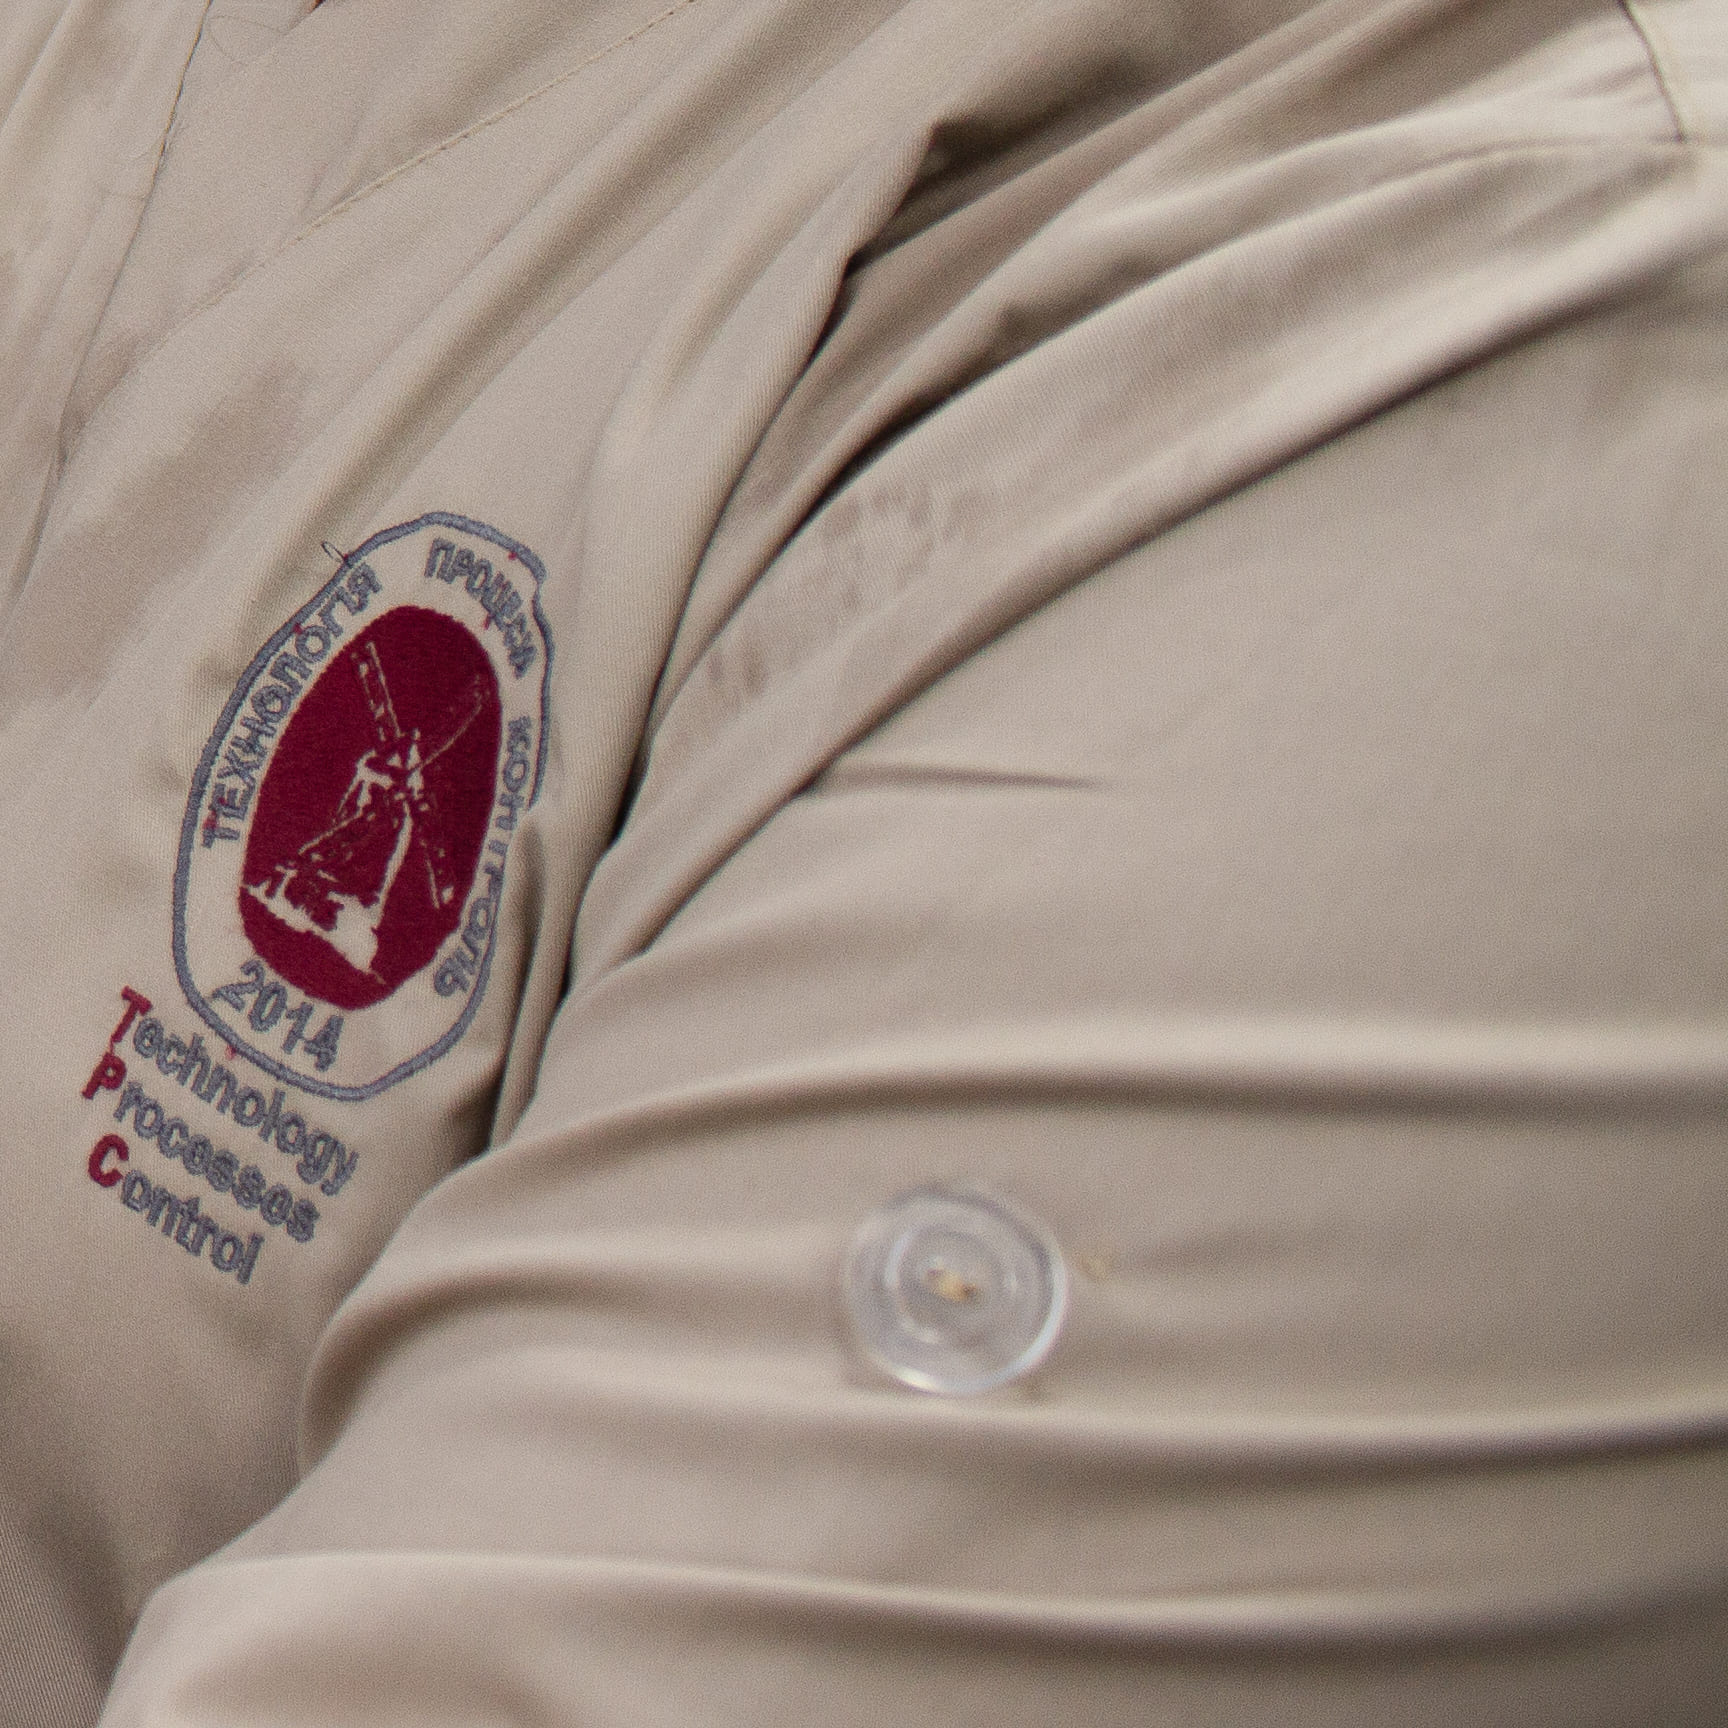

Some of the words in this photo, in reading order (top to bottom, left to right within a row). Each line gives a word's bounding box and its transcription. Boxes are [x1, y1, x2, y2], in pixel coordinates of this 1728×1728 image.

[121, 985, 359, 1196] Technology
[212, 958, 345, 1072] 2014
[81, 1053, 320, 1243] Processes
[87, 1134, 265, 1285] Control
